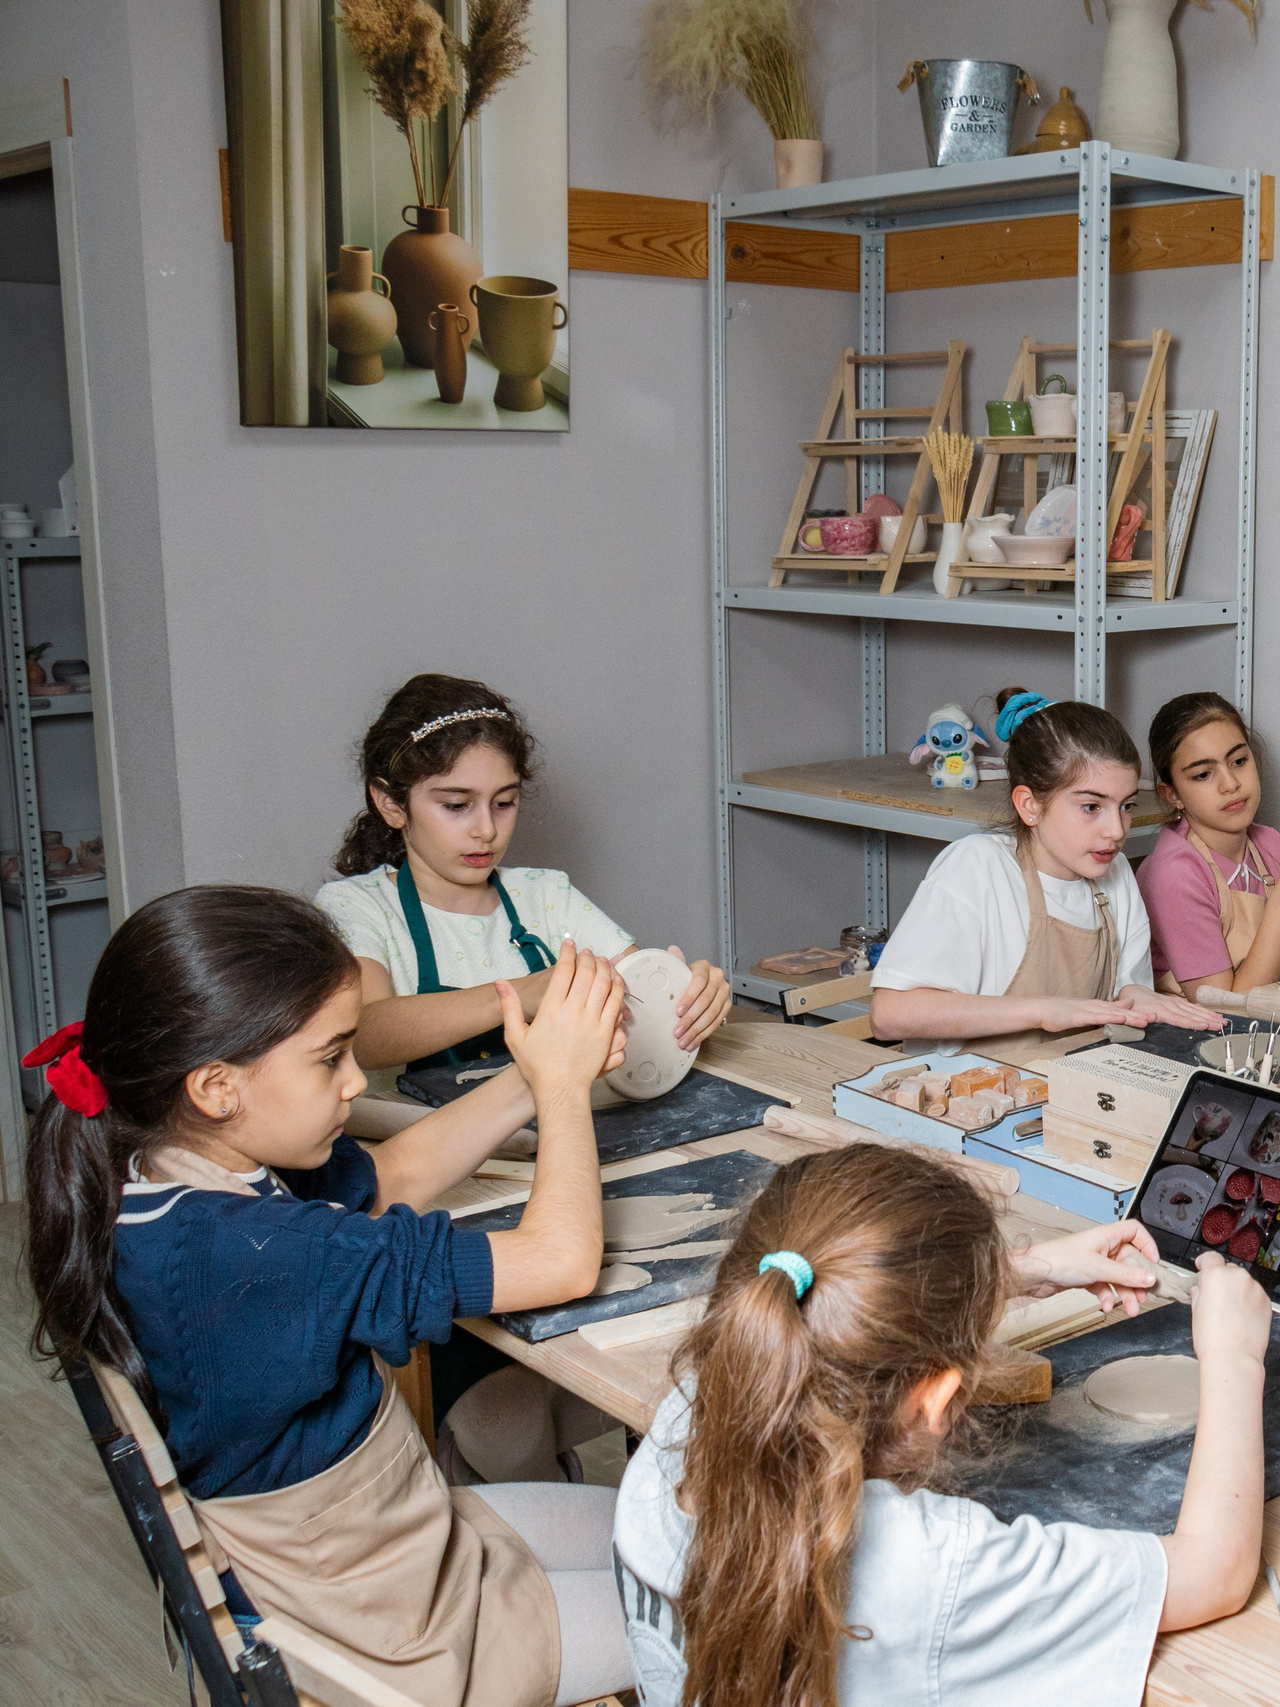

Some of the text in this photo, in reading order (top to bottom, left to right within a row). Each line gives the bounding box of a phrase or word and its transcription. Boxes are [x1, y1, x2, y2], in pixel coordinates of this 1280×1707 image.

[941, 95, 1007, 114] FLOWERS
[969, 110, 980, 122] &
[951, 123, 997, 134] GARDEN
